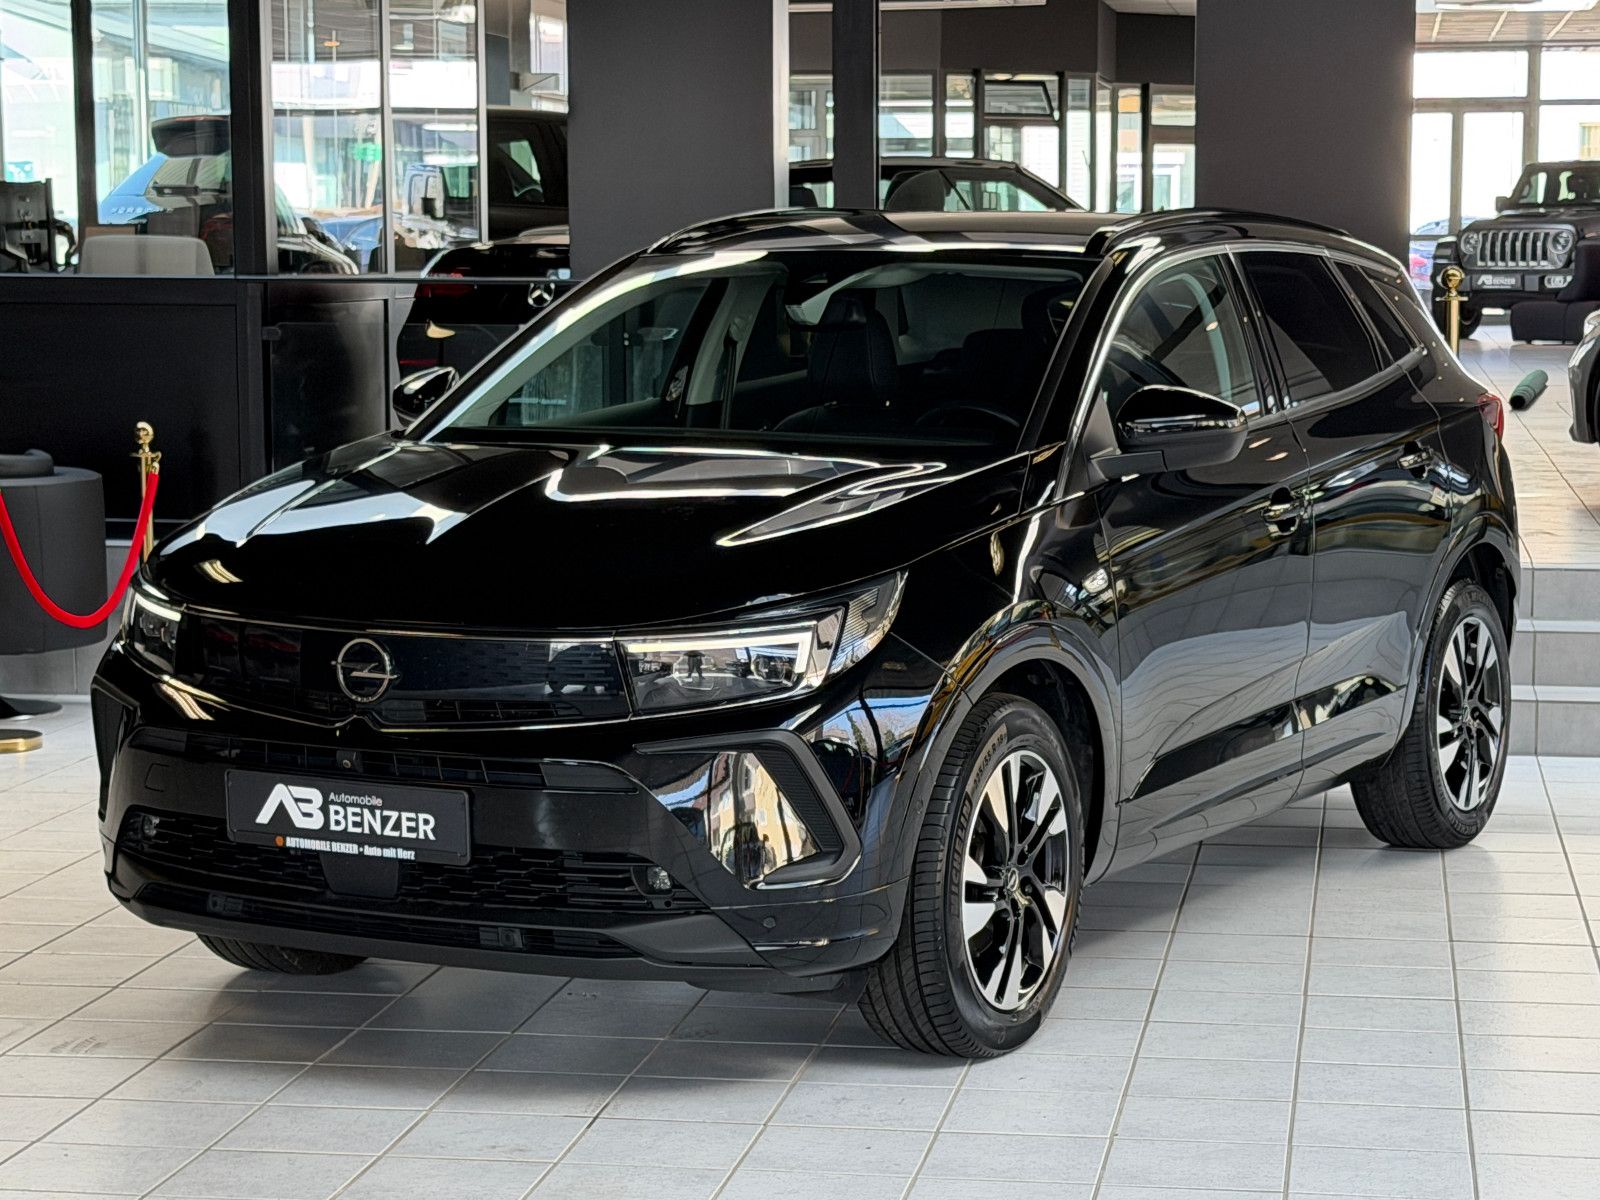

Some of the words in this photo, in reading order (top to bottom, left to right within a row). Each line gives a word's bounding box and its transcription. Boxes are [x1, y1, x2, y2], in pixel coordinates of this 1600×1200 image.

[328, 792, 383, 807] Automobile
[329, 804, 436, 841] BENZER
[285, 836, 332, 852] AUTOMOBILE
[331, 841, 359, 854] BENZER
[949, 801, 972, 917] MICHELIN
